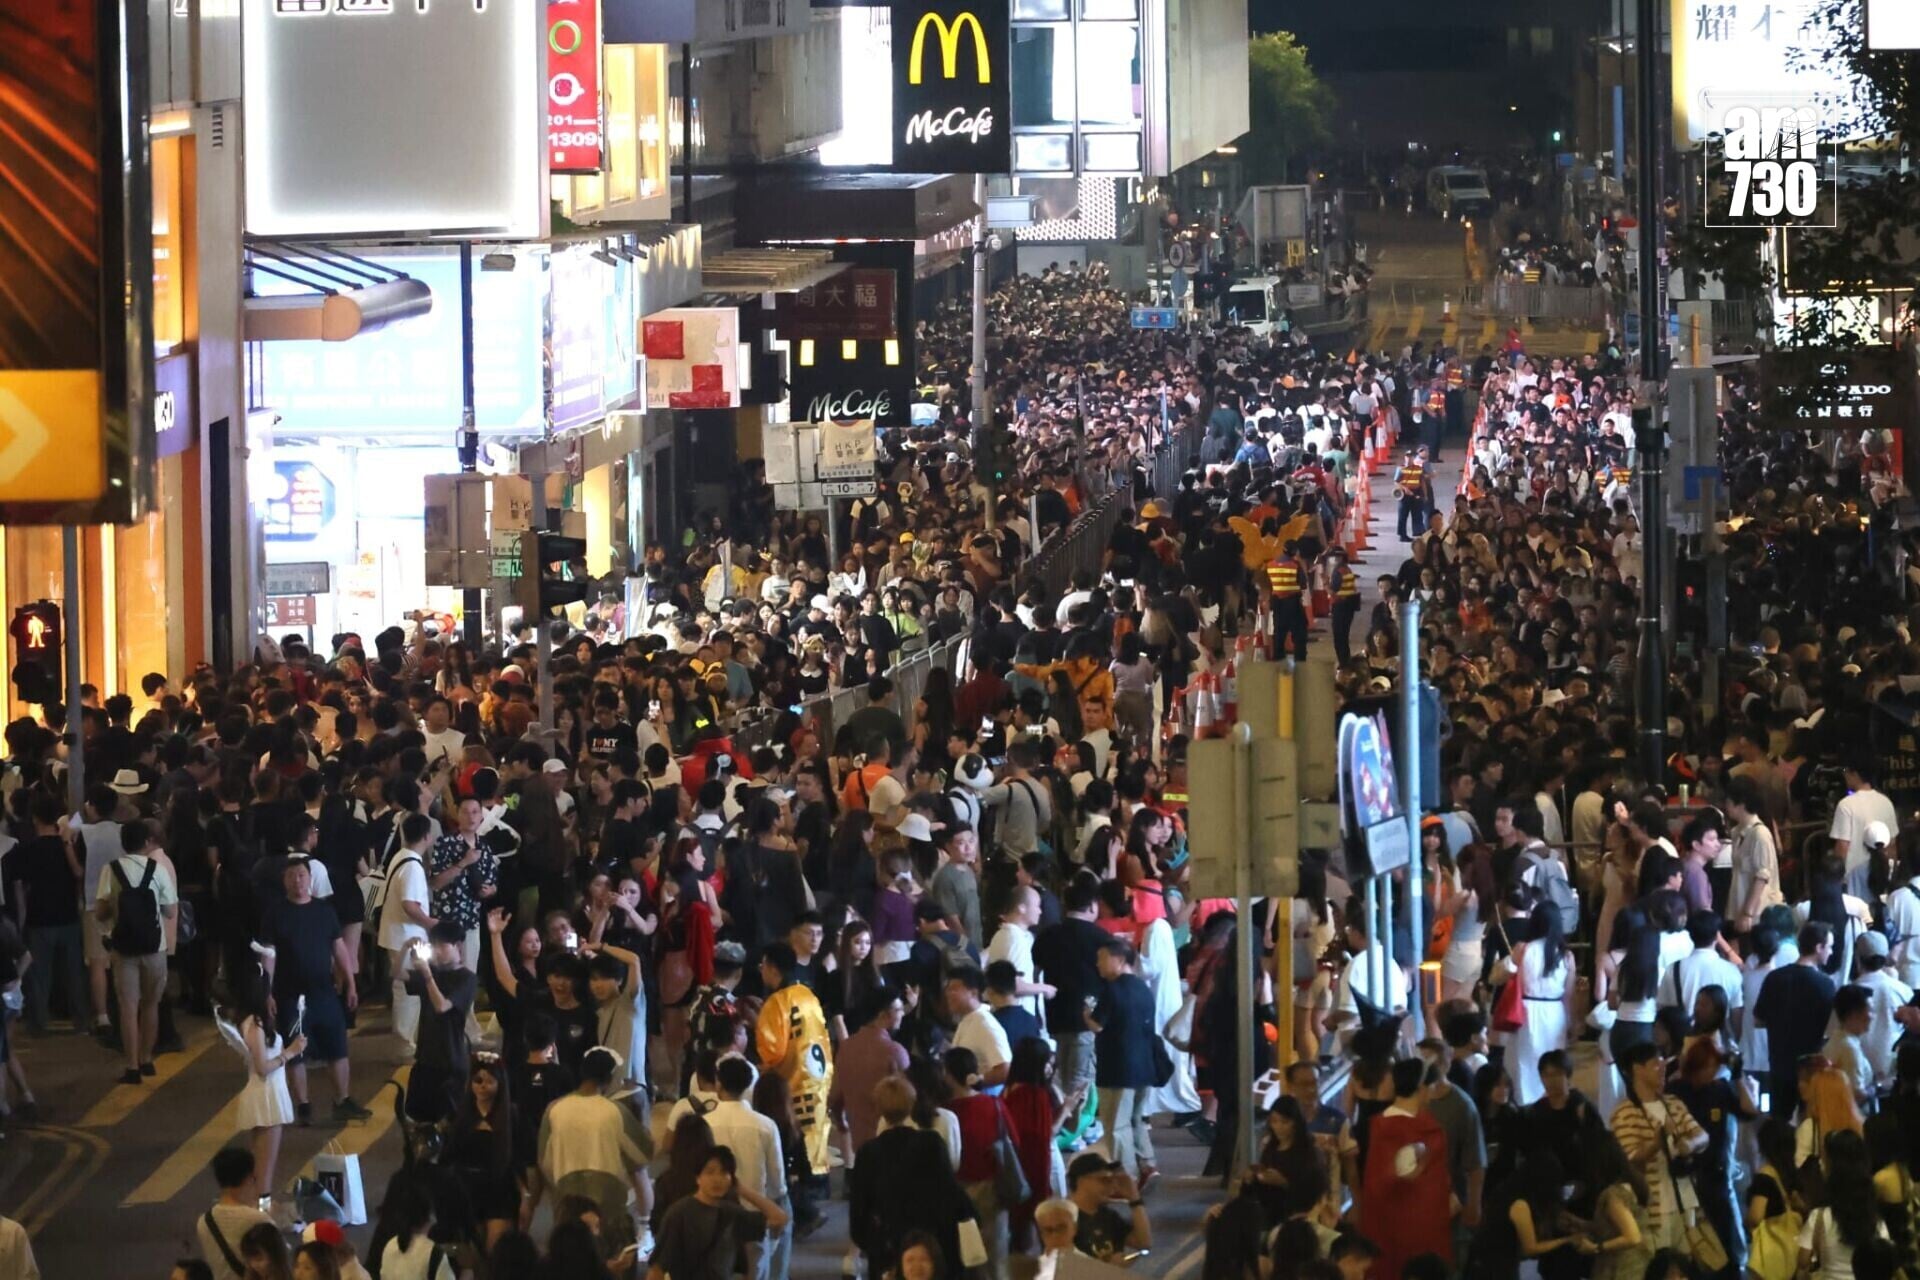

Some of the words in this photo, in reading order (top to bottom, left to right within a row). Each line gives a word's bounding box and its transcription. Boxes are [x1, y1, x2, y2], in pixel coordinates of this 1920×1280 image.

[548, 131, 597, 147] 1309
[905, 107, 993, 144] McCafé
[795, 284, 877, 308] 周大福
[807, 389, 891, 423] McCafé
